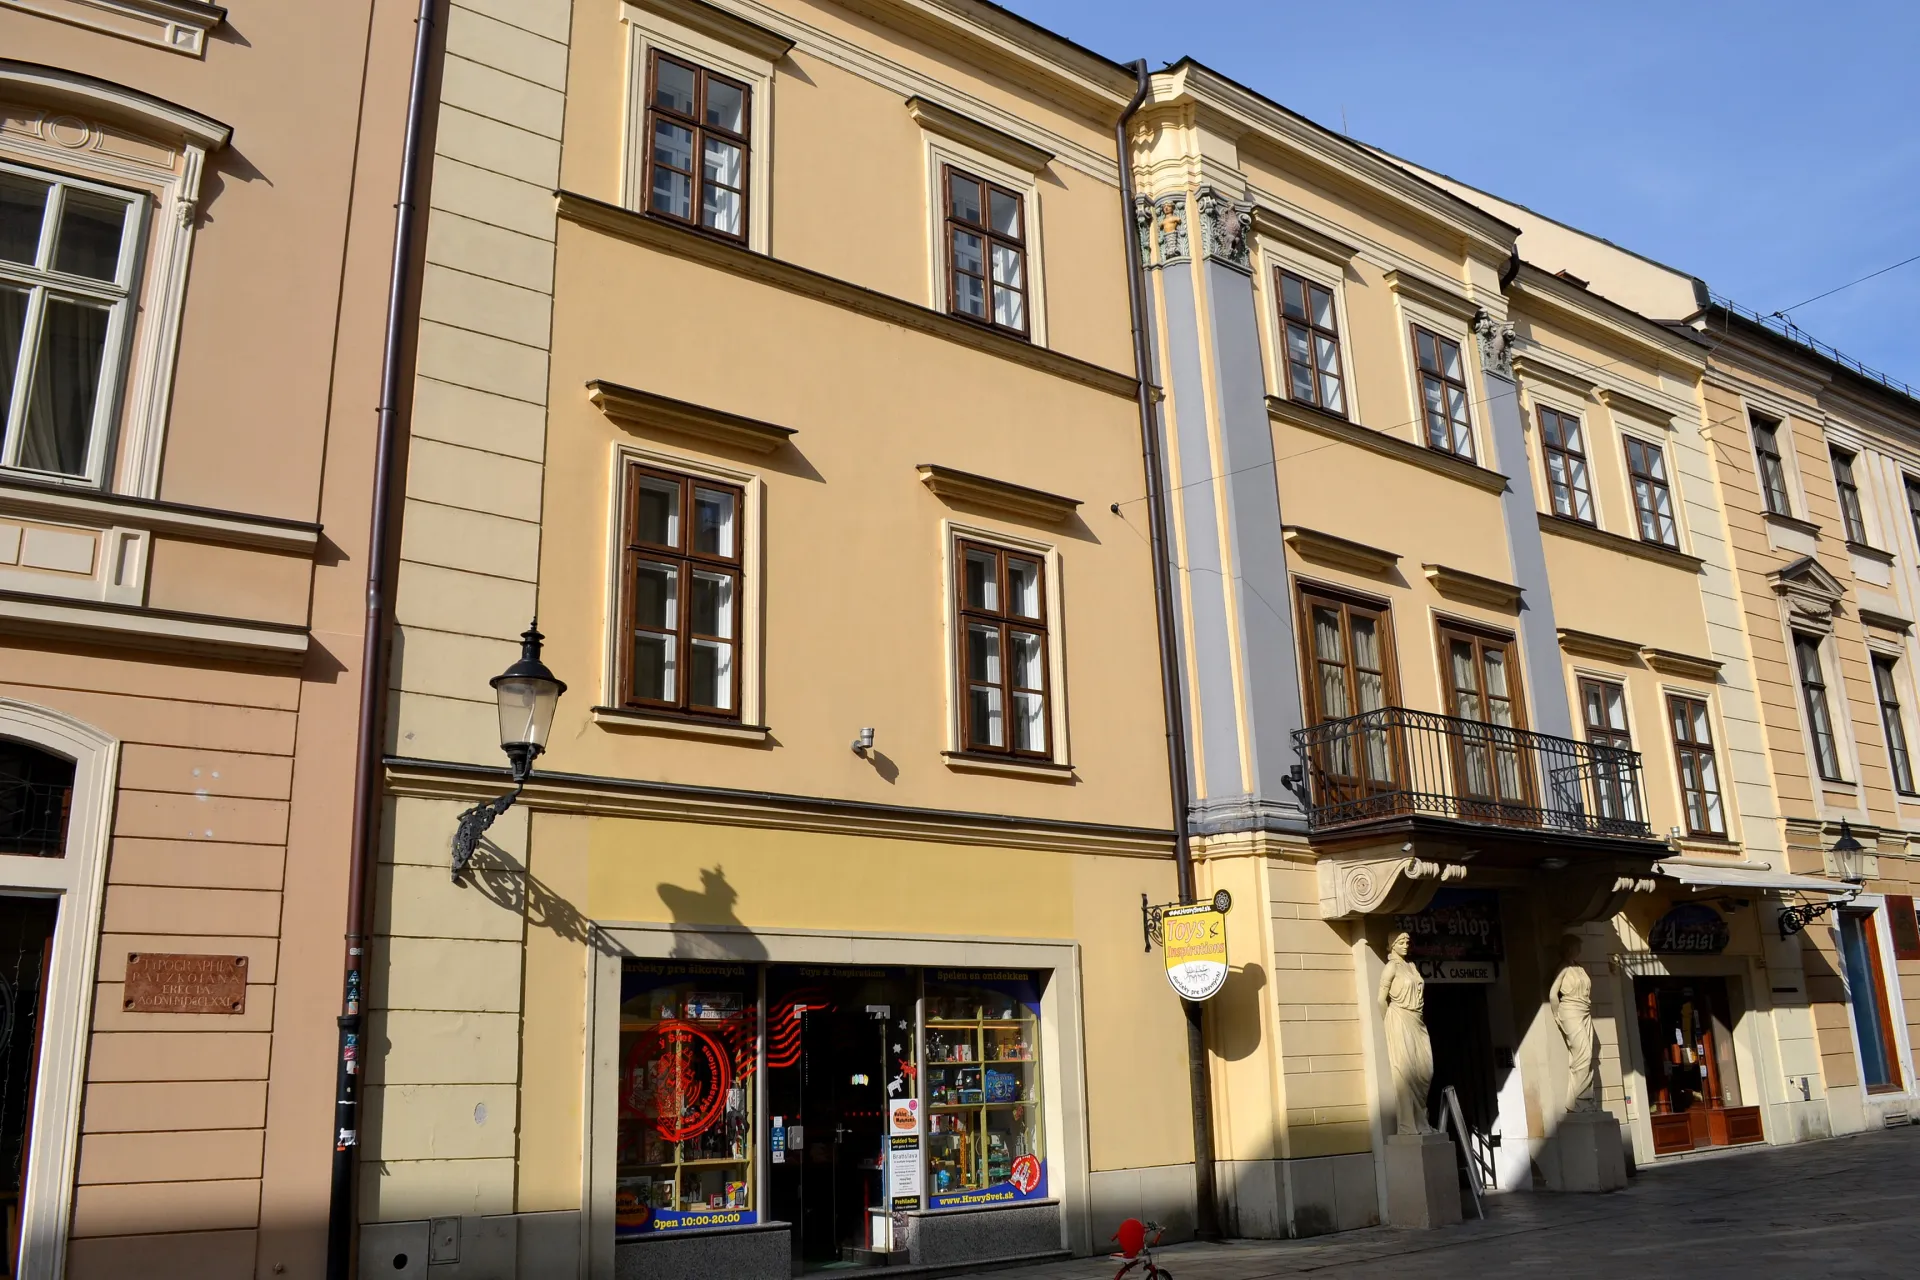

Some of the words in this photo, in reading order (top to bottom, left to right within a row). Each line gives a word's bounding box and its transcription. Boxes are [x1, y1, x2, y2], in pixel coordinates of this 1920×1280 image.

[1166, 919, 1205, 943] Toys
[1448, 910, 1490, 946] shop
[1661, 920, 1714, 950] Assisi
[1166, 942, 1225, 958] Inspirations
[144, 959, 235, 973] TYPOGRAPHIA
[667, 965, 686, 976] pre
[1449, 968, 1489, 978] CASHMERE
[937, 970, 967, 982] Spelen
[969, 972, 981, 980] en
[982, 971, 1029, 981] ontdekken
[702, 1045, 719, 1105] Inspirations
[939, 1192, 1014, 1206] www.HravySvet.sk
[653, 1219, 679, 1230] Open
[681, 1213, 740, 1227] 10:00-20:00
